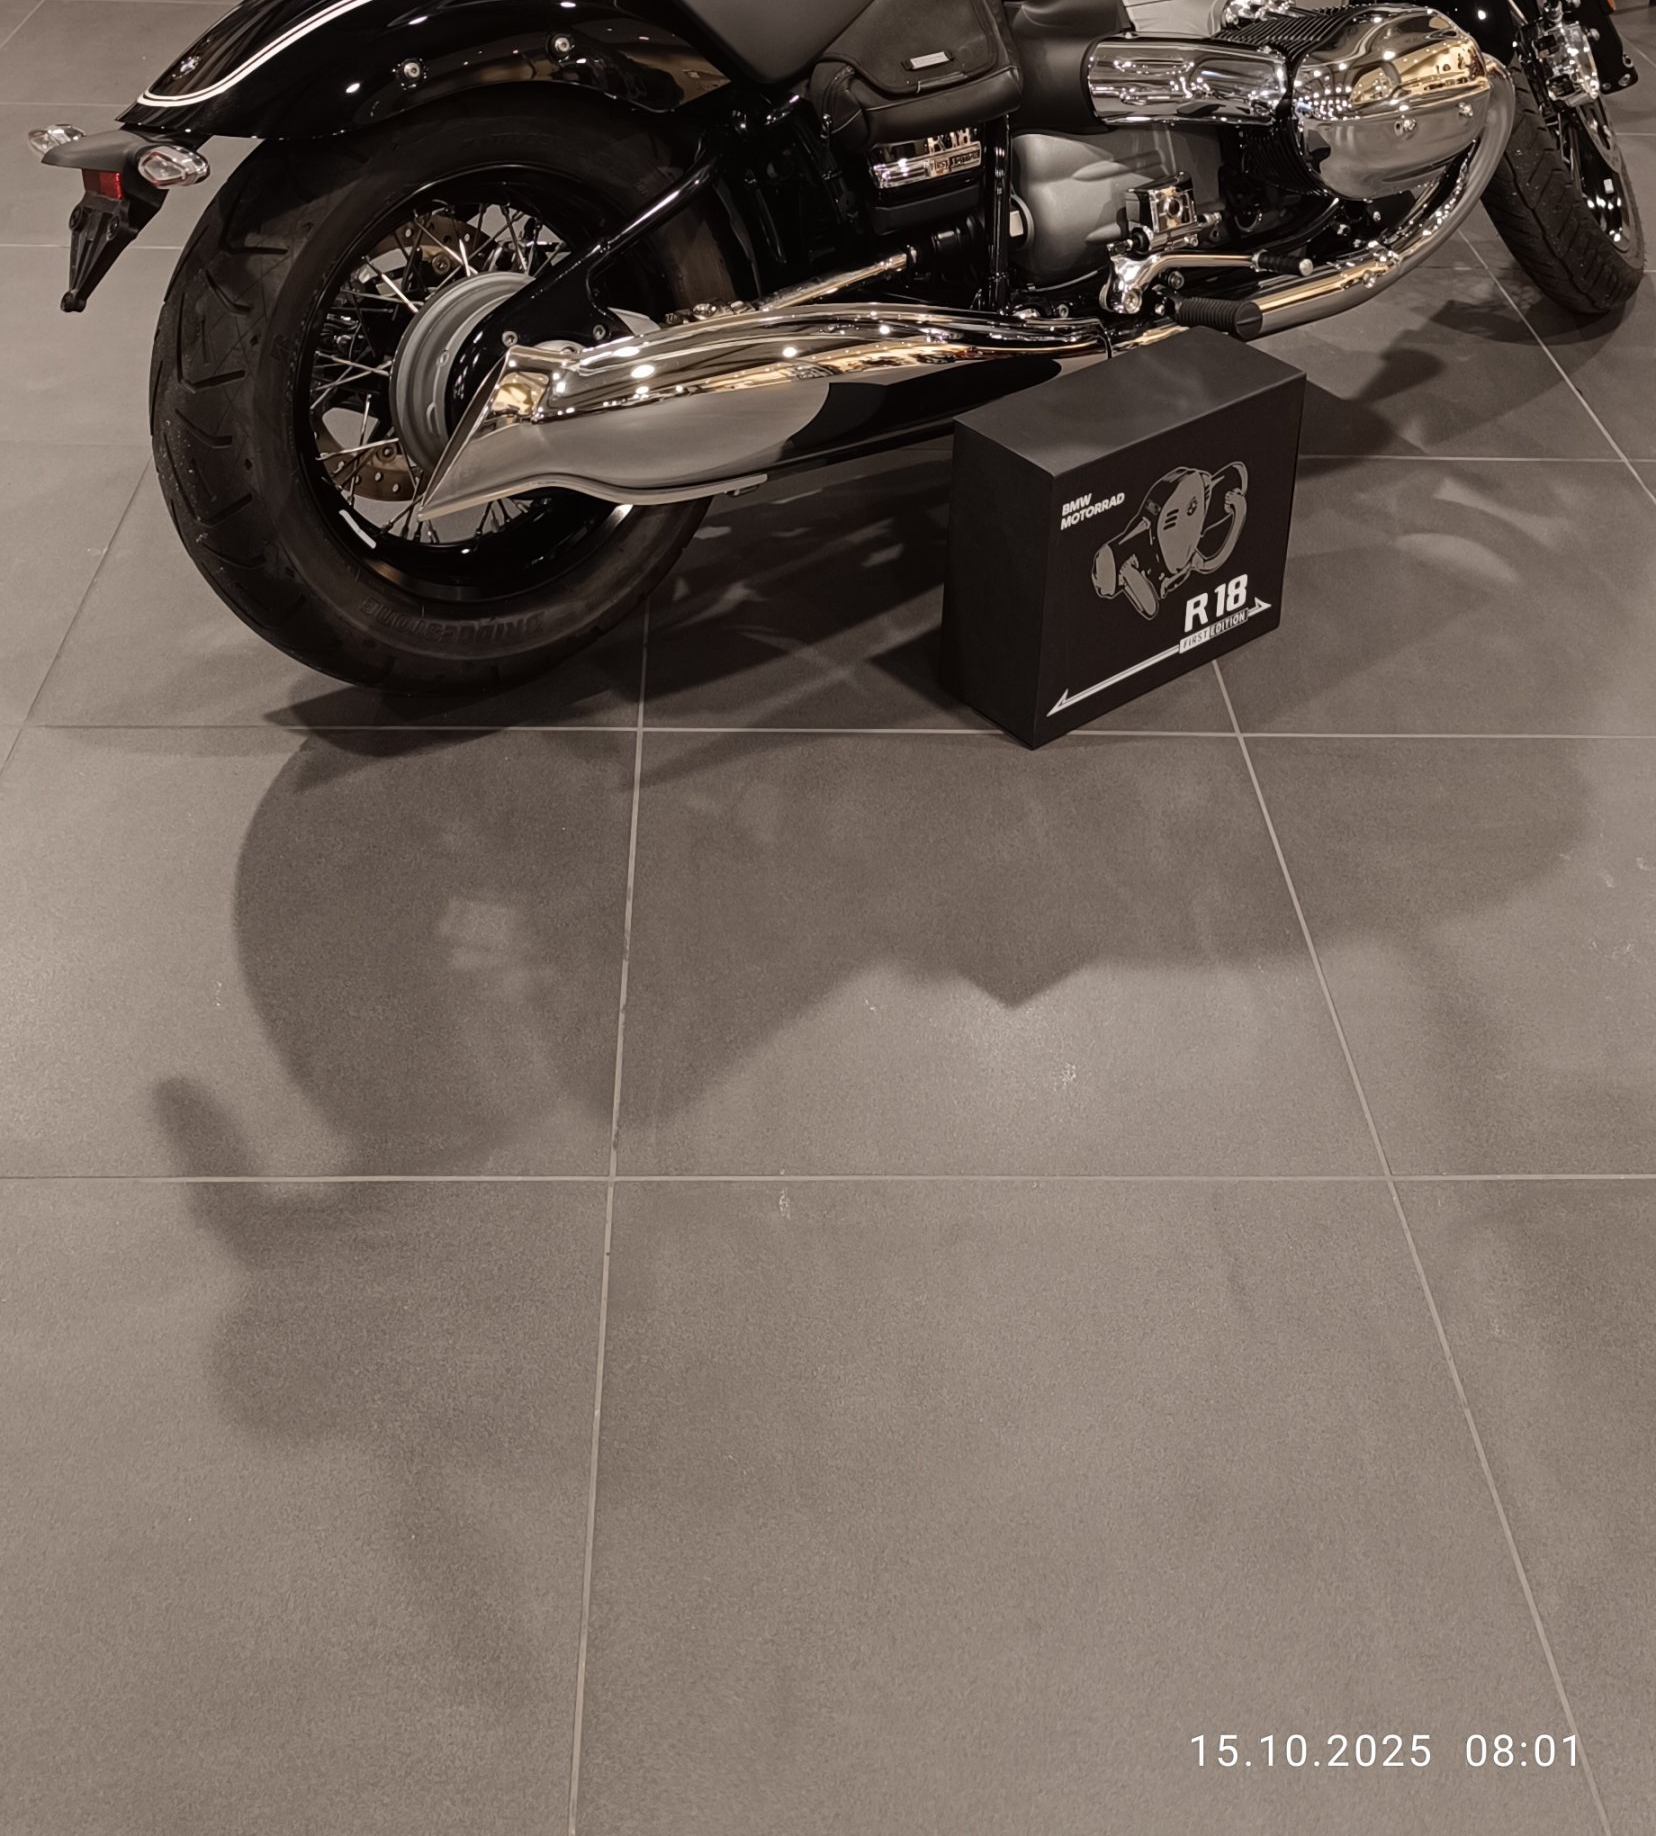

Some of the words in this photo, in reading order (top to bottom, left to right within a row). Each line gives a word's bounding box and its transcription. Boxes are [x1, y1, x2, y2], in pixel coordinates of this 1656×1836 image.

[1060, 492, 1126, 532] MOTORRAD
[1061, 492, 1093, 517] BMW
[1184, 592, 1209, 633] R
[1213, 573, 1249, 618] 18
[1183, 629, 1208, 650] FIRST
[1209, 611, 1246, 638] EDITION
